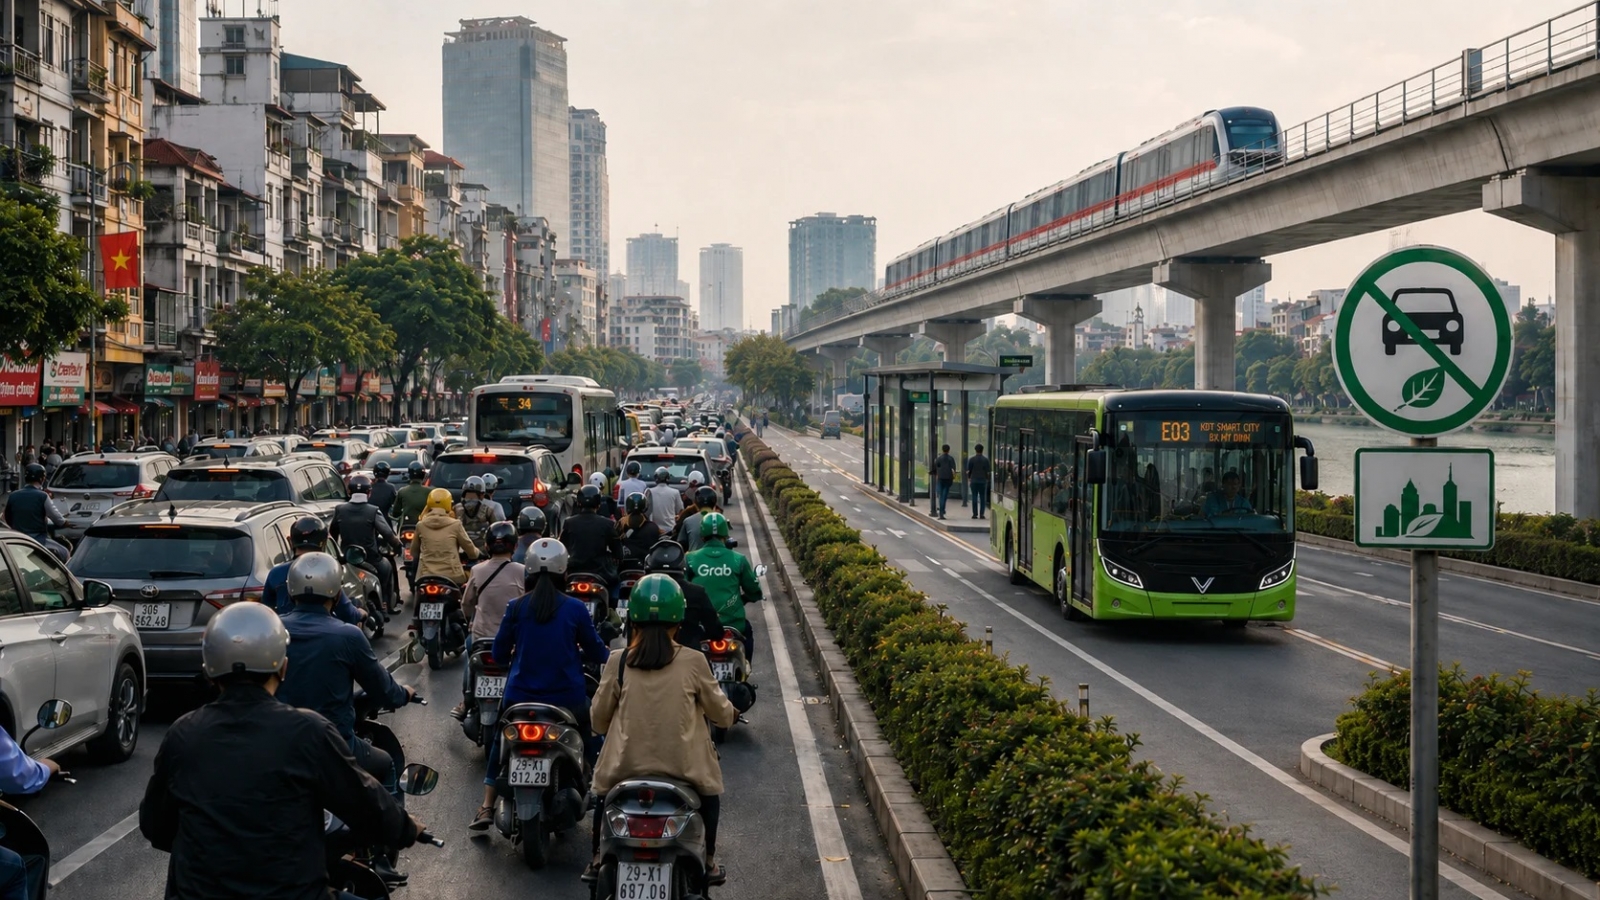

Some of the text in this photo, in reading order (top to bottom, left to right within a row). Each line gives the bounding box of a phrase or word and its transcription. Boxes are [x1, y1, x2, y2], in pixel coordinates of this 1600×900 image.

[518, 397, 532, 410] 34
[1161, 421, 1191, 442] E03
[1243, 422, 1261, 433] CITY
[697, 563, 732, 577] Grab
[515, 759, 543, 771] 29-X1
[626, 865, 662, 882] 29-X1
